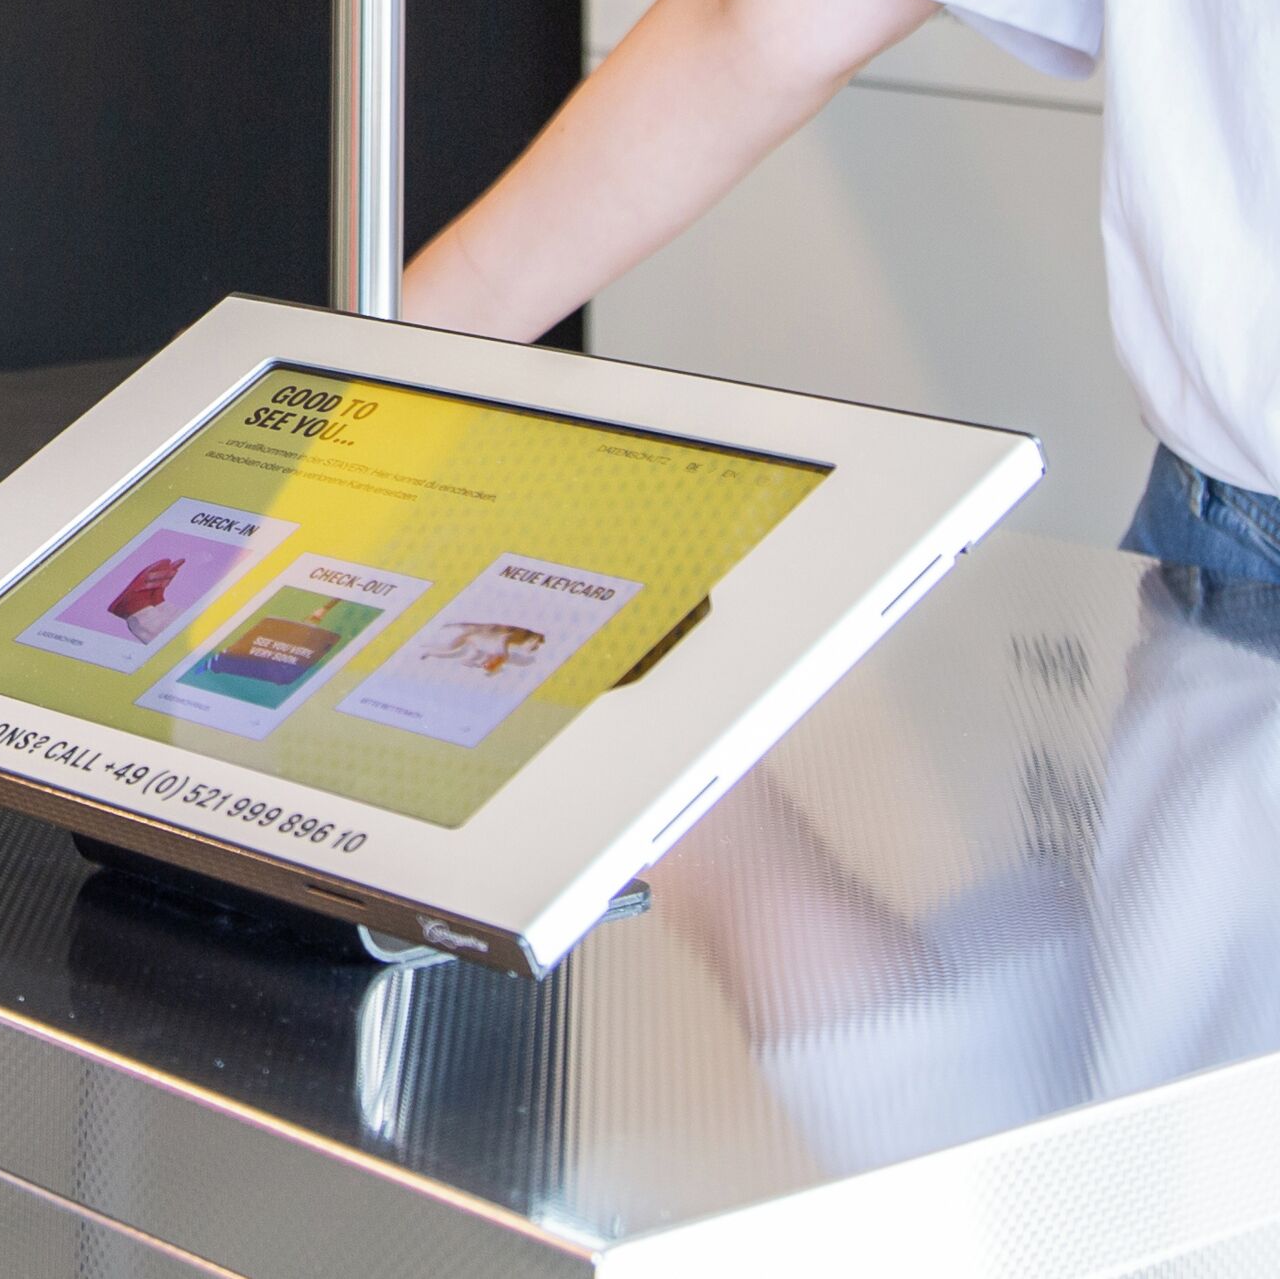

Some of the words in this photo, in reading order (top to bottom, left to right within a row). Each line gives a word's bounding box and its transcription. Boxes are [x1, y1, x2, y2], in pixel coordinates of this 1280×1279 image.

[271, 386, 342, 413] GOOD
[340, 398, 379, 420] TO
[244, 407, 297, 434] SEE
[290, 417, 355, 447] YOU...
[190, 512, 260, 536] CHECK-IN
[309, 567, 398, 596] CHECK-OUT
[500, 565, 546, 586] NEUE
[541, 576, 616, 601] KEYCARD
[44, 741, 101, 772] CALL
[105, 762, 150, 785] +49
[142, 770, 190, 802] (0)
[183, 783, 233, 812] 521
[227, 798, 283, 827] 999
[279, 813, 335, 844] 896
[331, 830, 368, 854] 10
